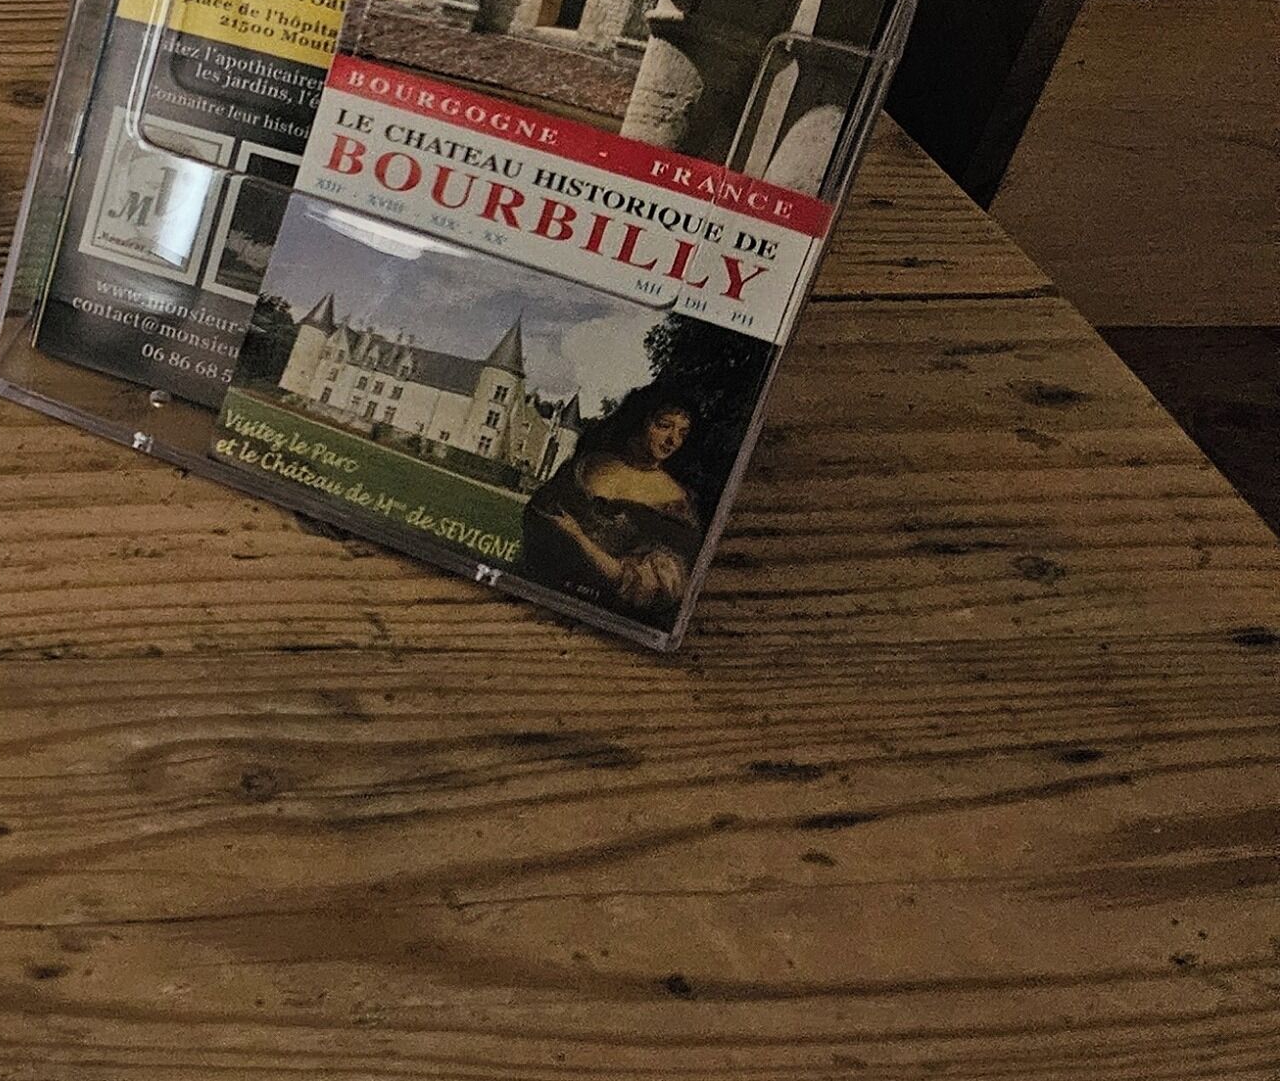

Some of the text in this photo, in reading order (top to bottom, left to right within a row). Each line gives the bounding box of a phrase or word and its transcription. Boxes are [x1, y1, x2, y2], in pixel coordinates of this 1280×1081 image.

[324, 132, 769, 302] BOURBILLY
[335, 108, 375, 135] LE
[385, 123, 524, 180] CHATEAU
[534, 167, 724, 243] HISTORIQUE
[736, 228, 780, 262] DE
[142, 343, 165, 362] 06
[169, 351, 190, 370] 86
[195, 361, 217, 379] 68
